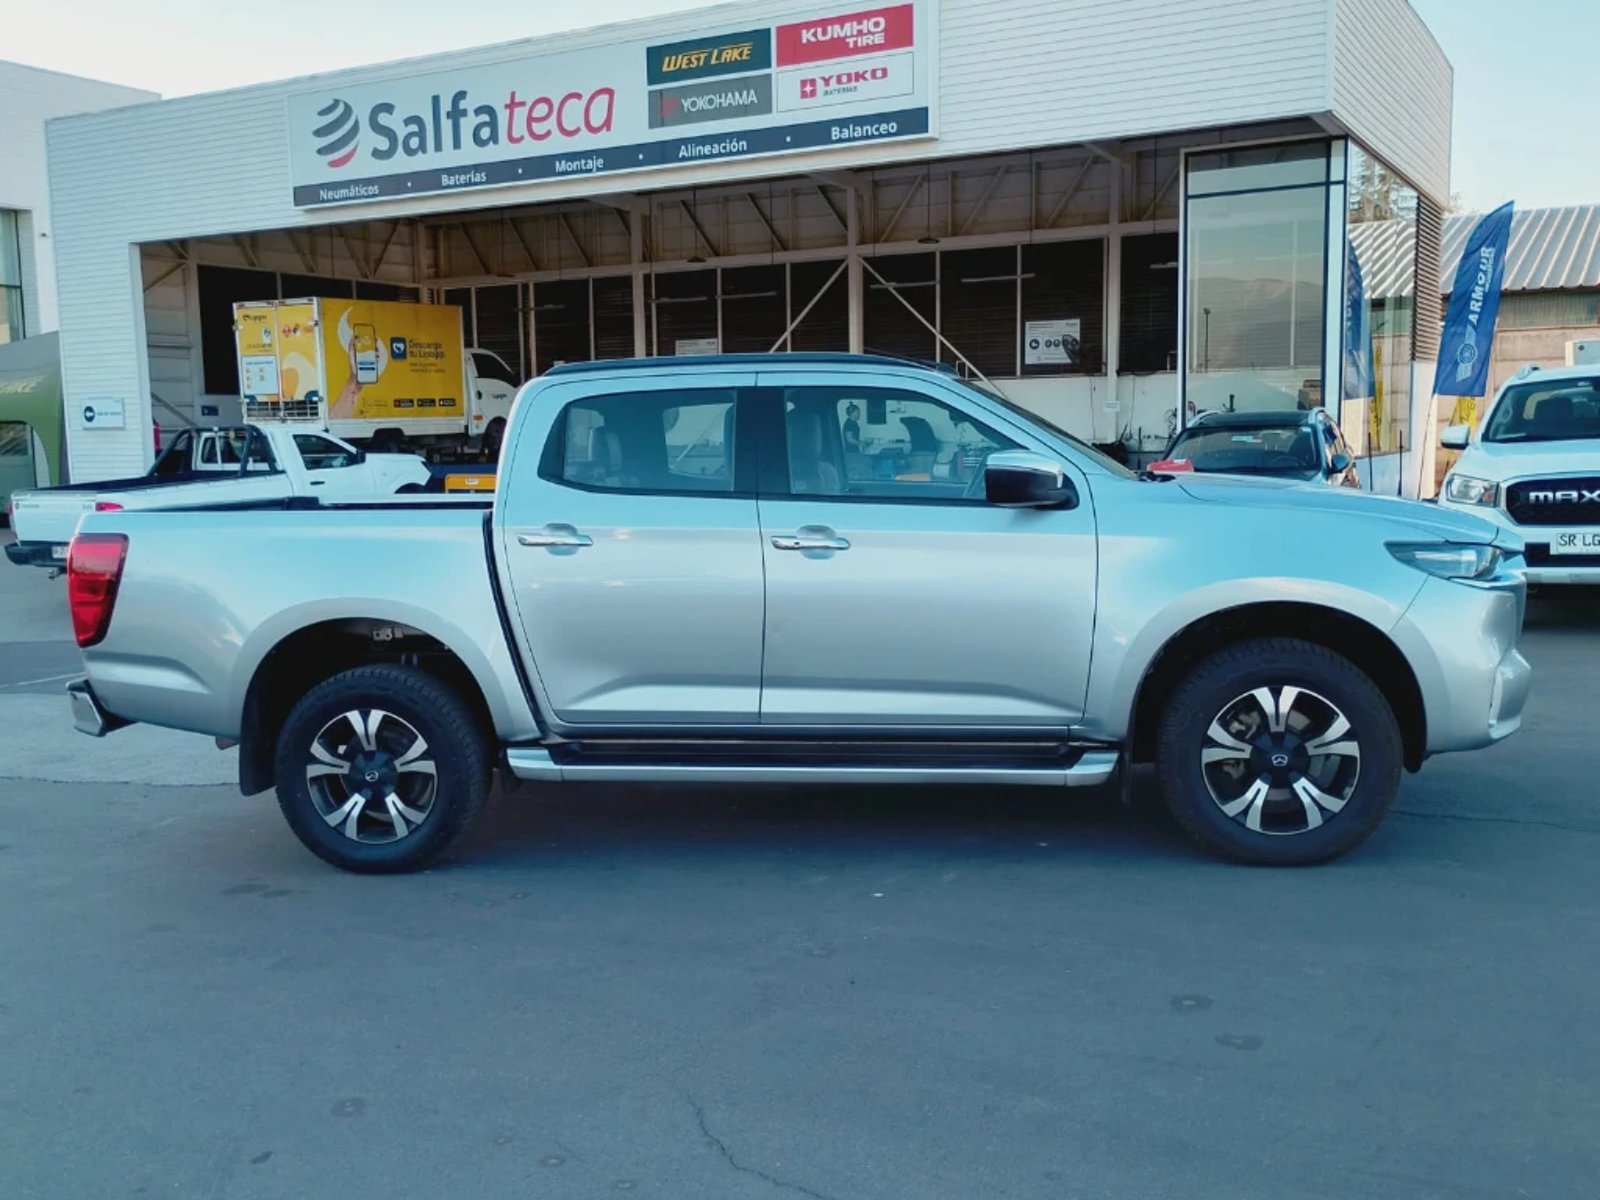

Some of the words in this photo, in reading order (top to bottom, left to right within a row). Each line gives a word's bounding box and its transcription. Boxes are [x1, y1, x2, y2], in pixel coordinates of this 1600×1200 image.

[801, 16, 886, 44] KUMHO
[845, 32, 886, 49] TIRE
[661, 49, 706, 73] WEST
[710, 42, 753, 65] LAKE
[818, 67, 888, 88] YOKO
[681, 89, 758, 113] YOKOHAMA
[368, 87, 615, 161] Salfateca
[319, 183, 379, 200] Neumáticos
[441, 168, 487, 187] Baterías
[555, 155, 604, 173] Montaje
[678, 138, 748, 159] Alineación
[831, 121, 898, 141] Balanceo
[1468, 246, 1492, 326] ARMOUR
[1559, 534, 1576, 547] SR
